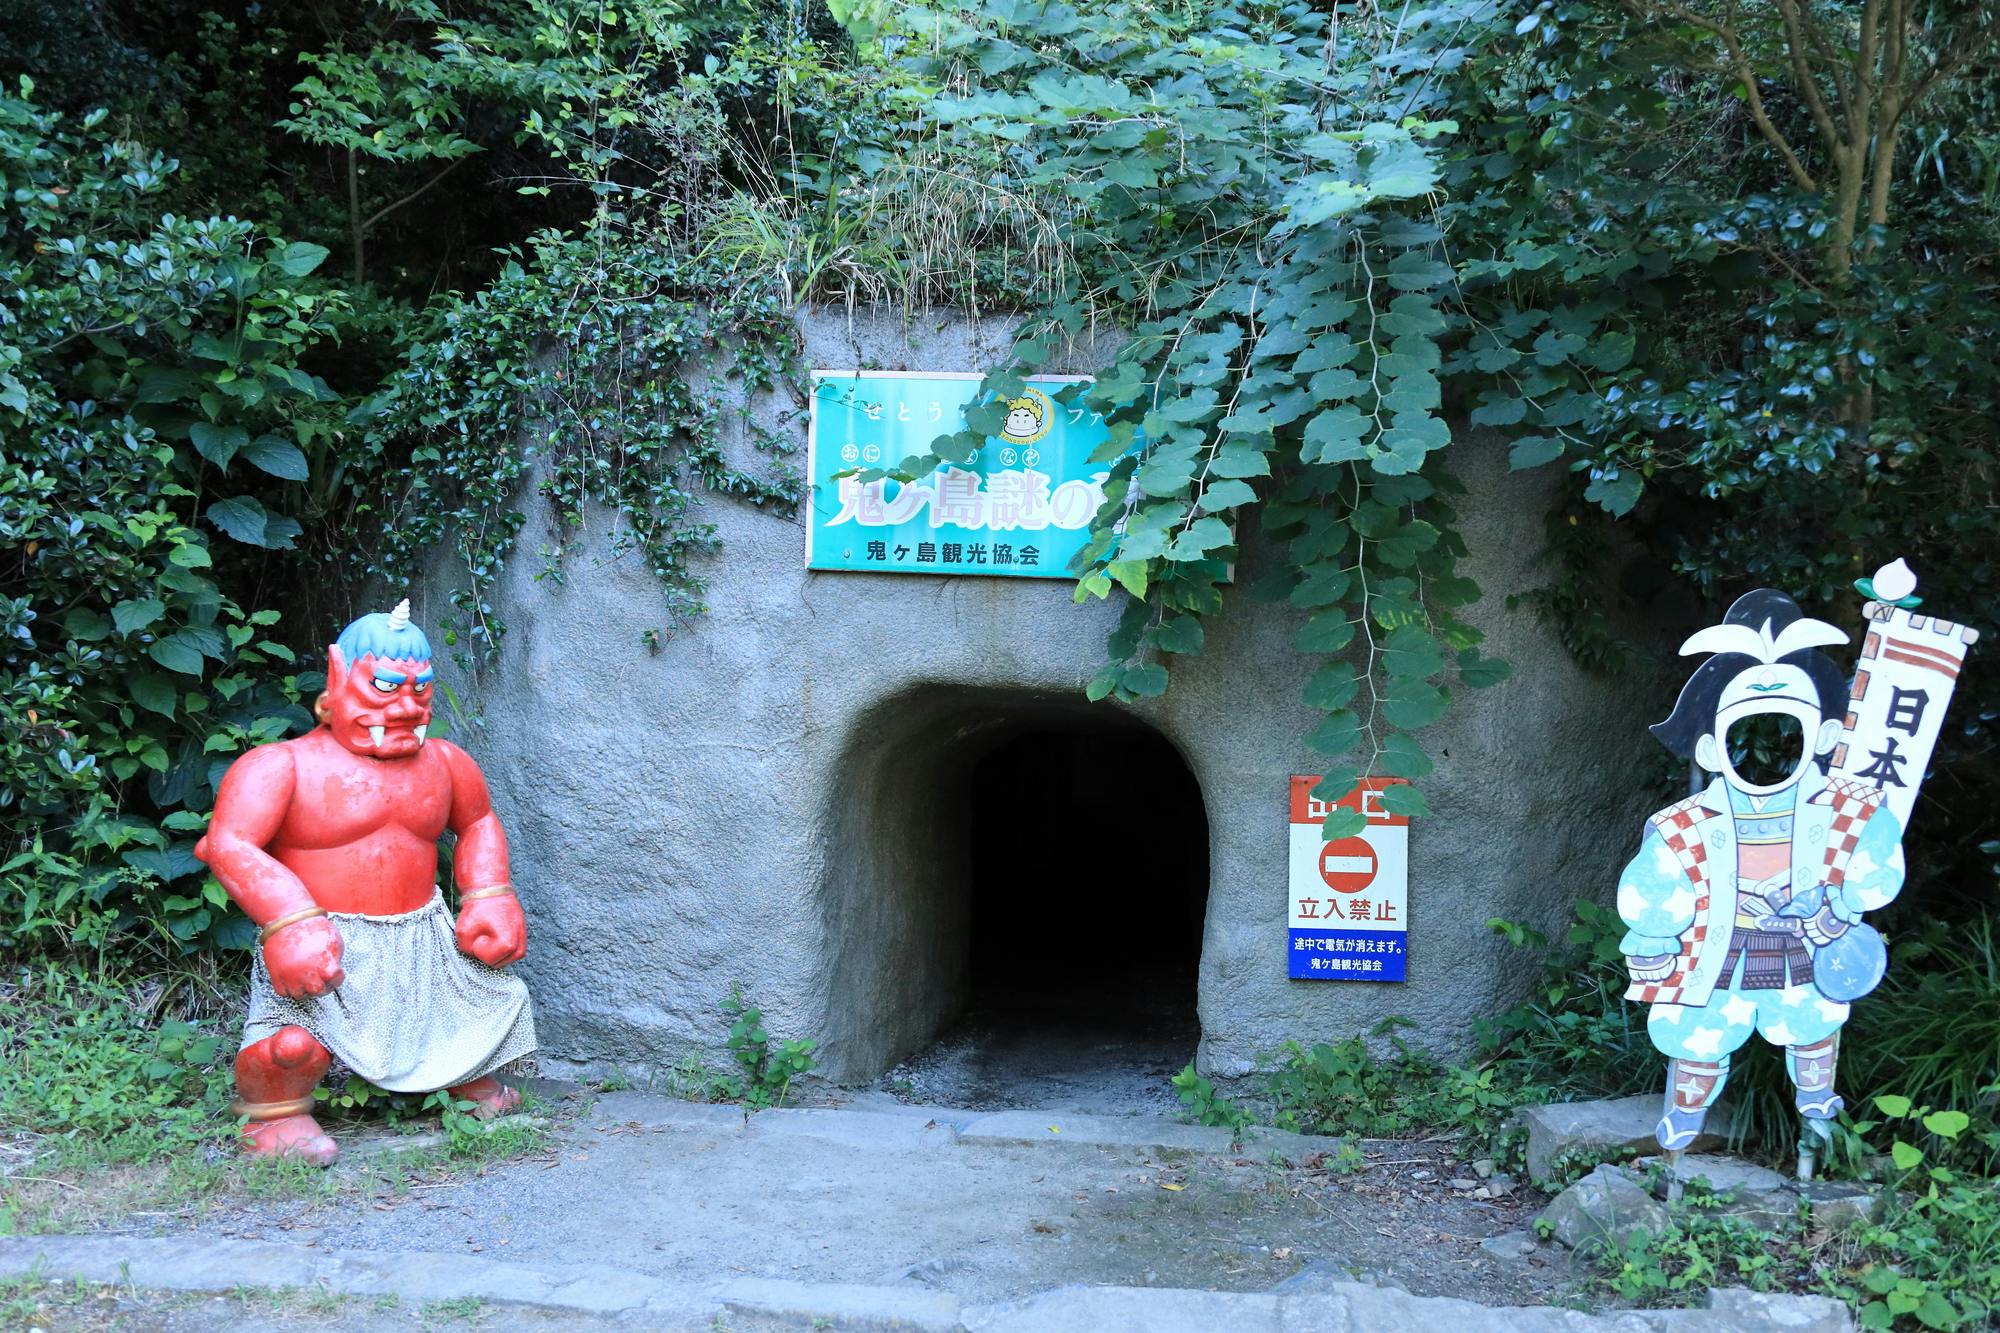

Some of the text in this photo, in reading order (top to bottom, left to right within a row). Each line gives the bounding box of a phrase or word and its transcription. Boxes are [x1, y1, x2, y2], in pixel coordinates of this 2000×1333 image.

[1854, 685, 1930, 790] 日本
[1298, 897, 1397, 922] 立入禁止
